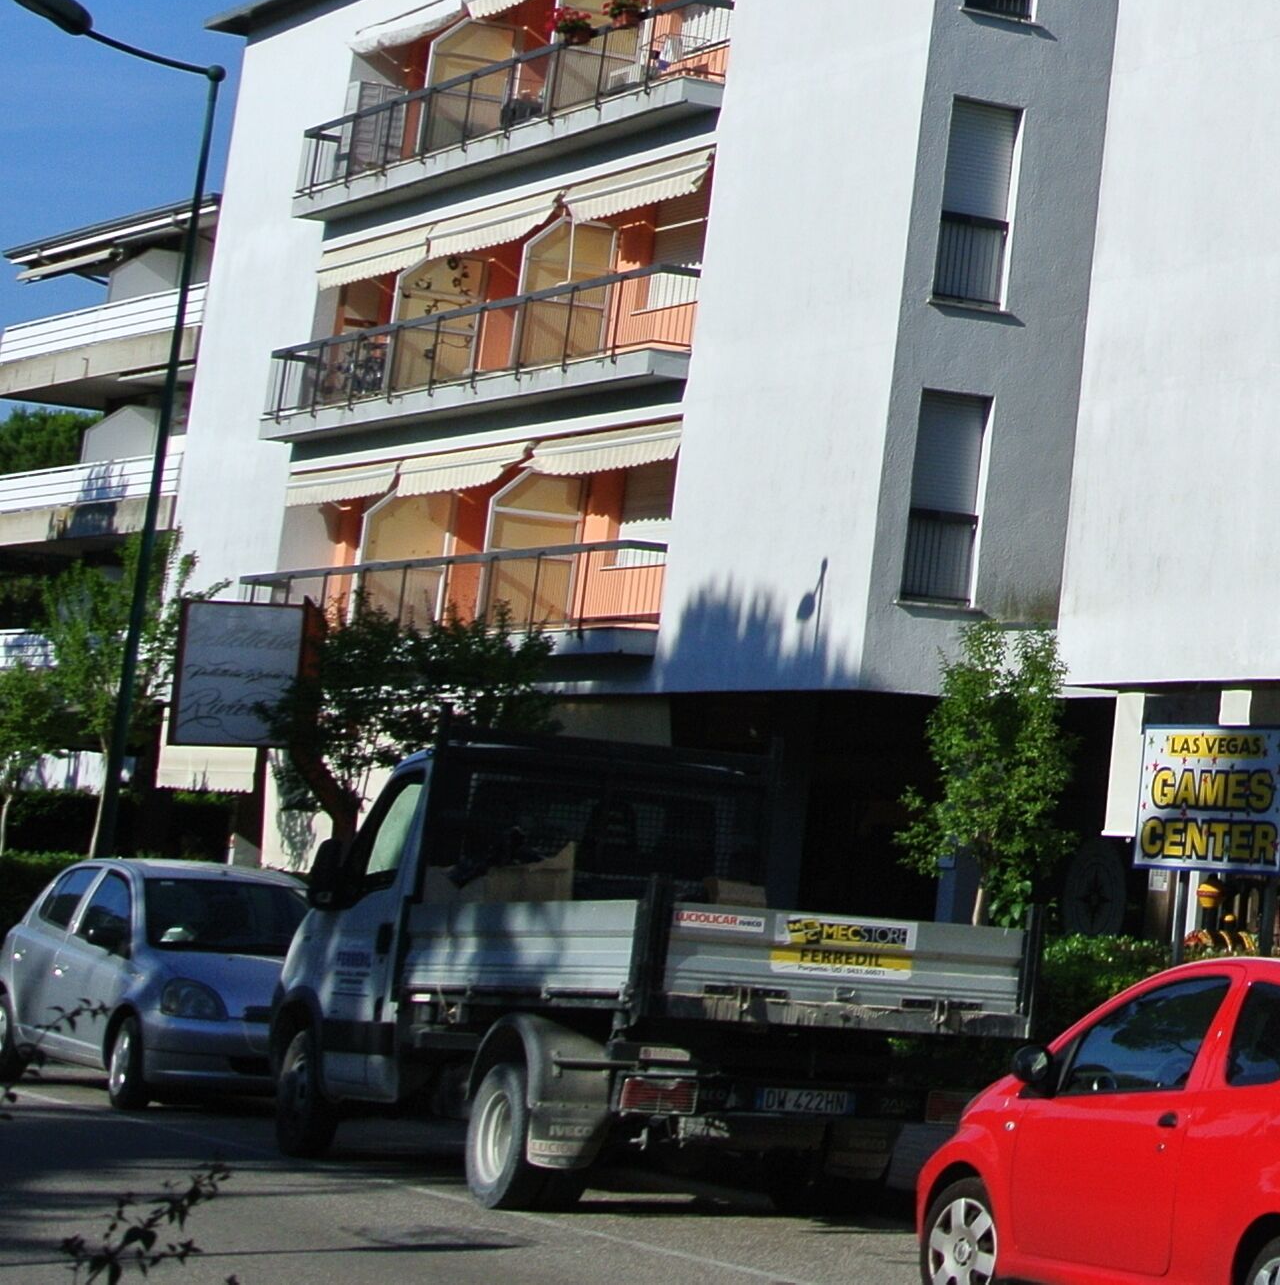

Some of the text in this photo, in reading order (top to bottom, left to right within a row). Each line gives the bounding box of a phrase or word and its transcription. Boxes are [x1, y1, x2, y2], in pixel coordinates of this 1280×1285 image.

[1170, 737, 1261, 756] LAS VEGAS
[1151, 767, 1275, 813] GAMES
[1140, 816, 1277, 866] CENTER
[675, 910, 737, 926] LUCIOLICAR
[822, 923, 908, 945] MECSTORE
[799, 948, 884, 968] FERREDIL
[765, 1089, 846, 1111] DW 422HN
[549, 1124, 594, 1137] IVECO
